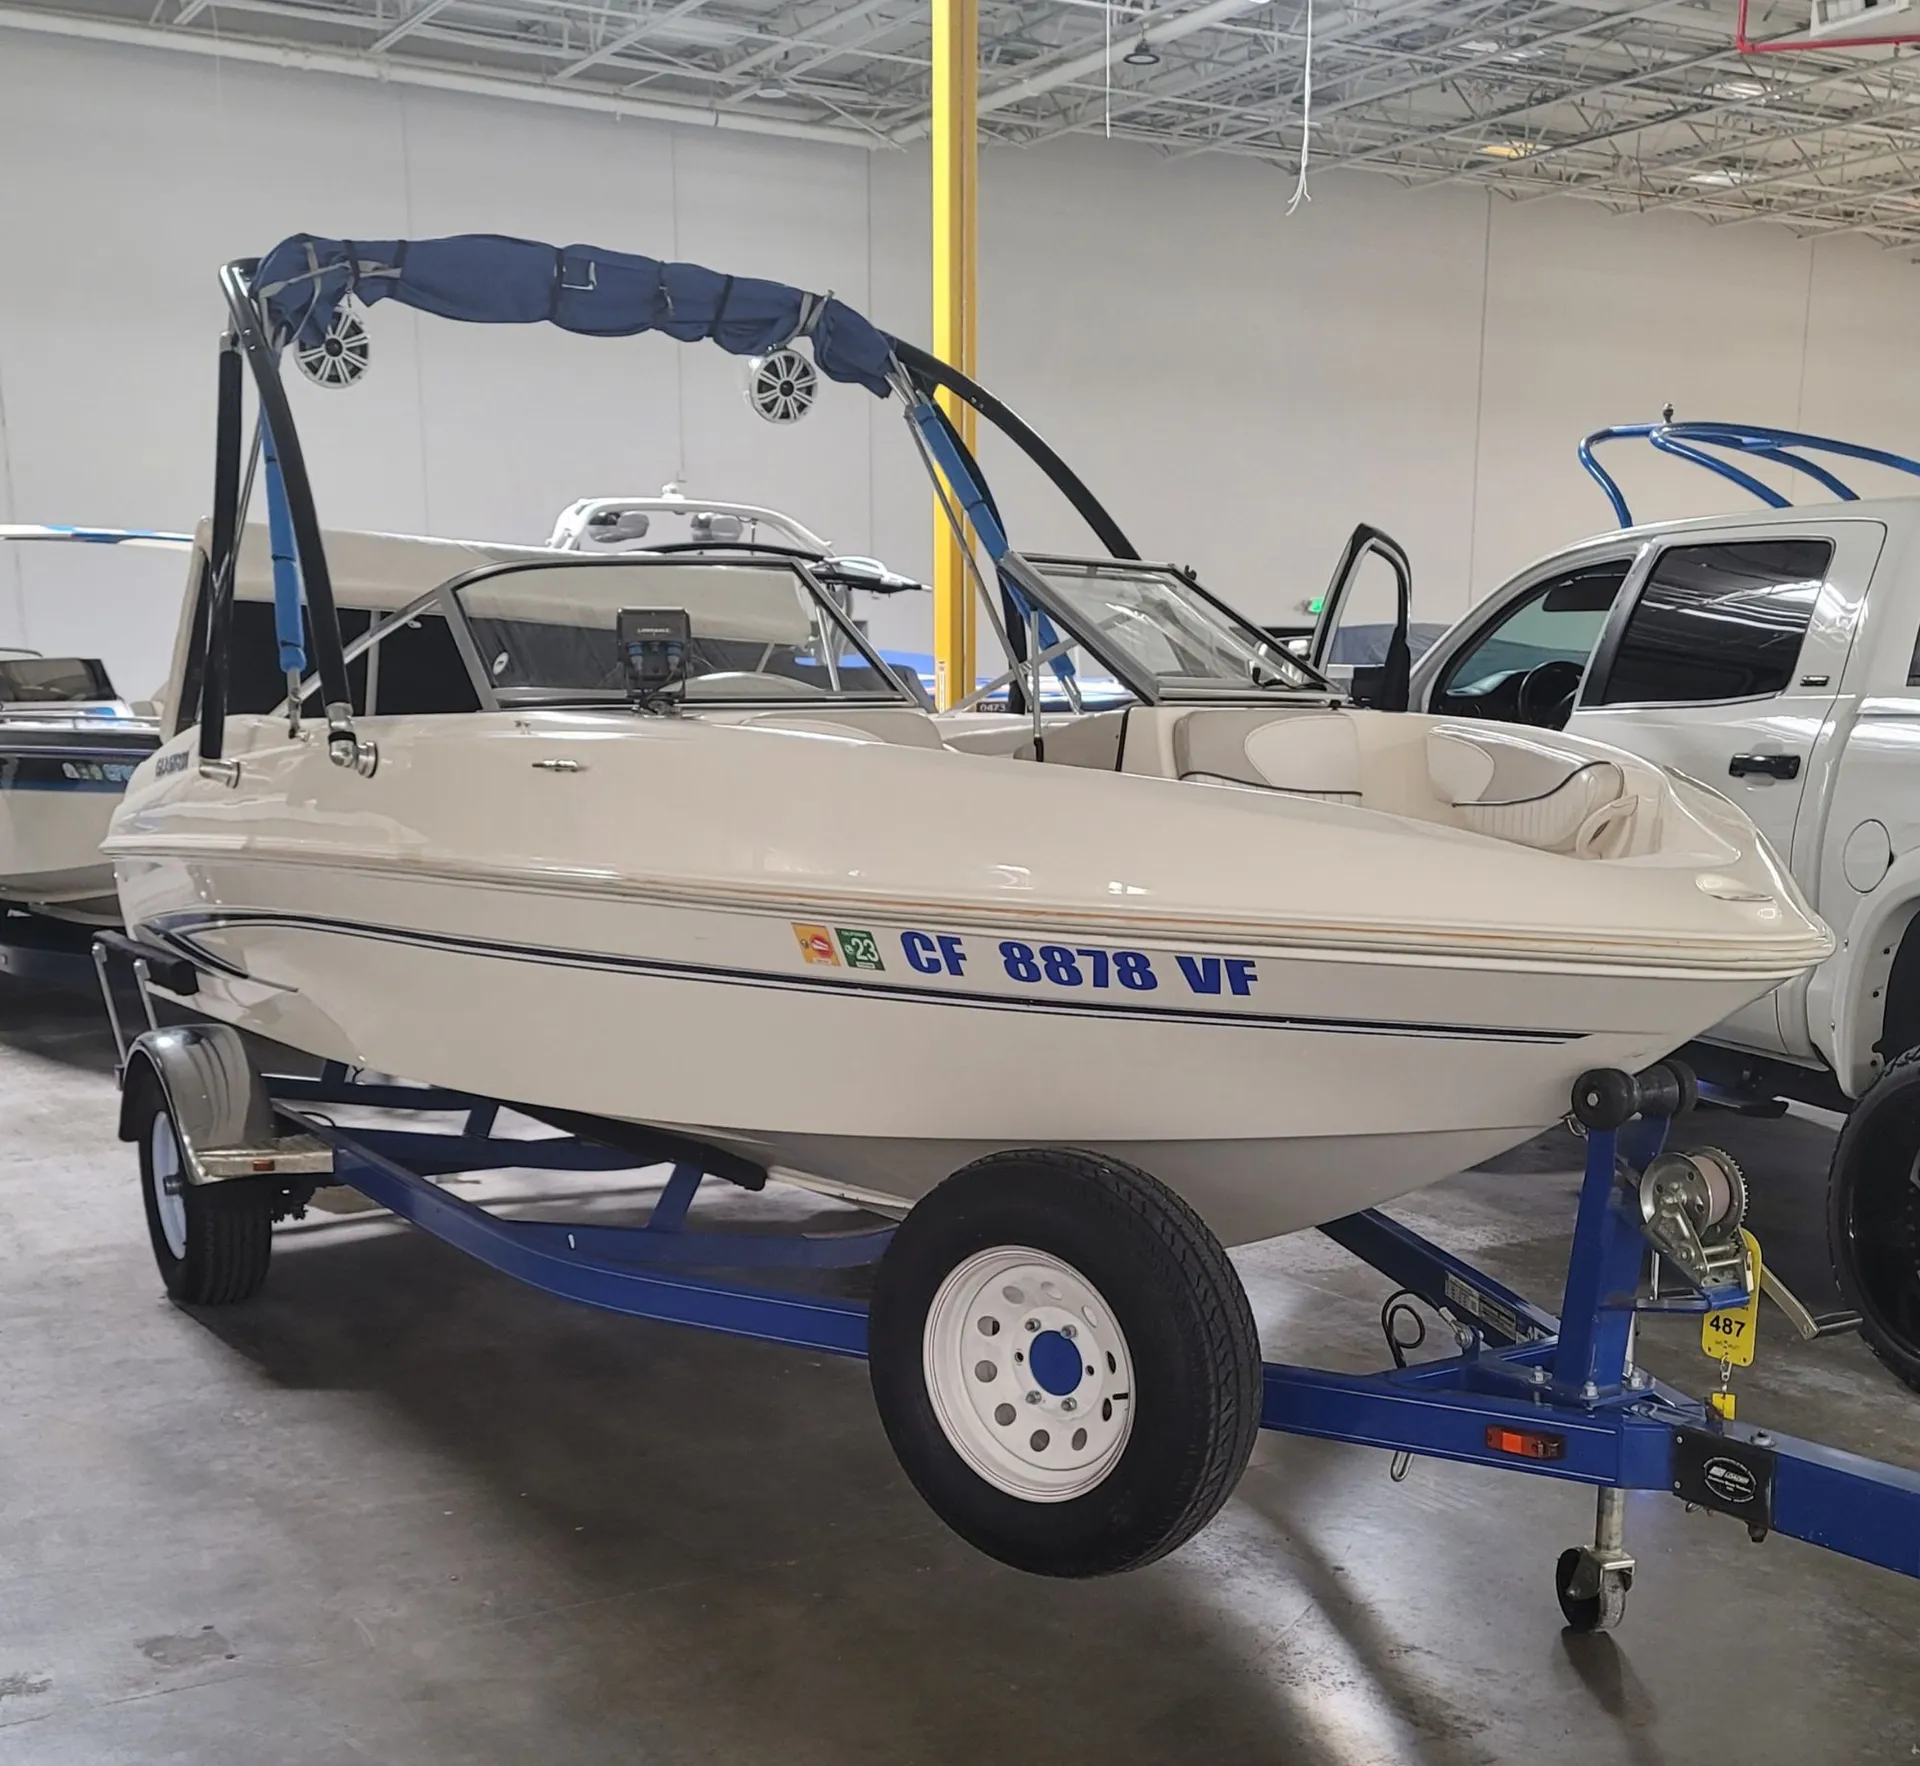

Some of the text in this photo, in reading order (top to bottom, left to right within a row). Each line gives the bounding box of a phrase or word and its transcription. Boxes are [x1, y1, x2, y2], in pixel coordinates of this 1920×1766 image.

[851, 937, 879, 963] 23
[900, 930, 1258, 996] CF 8878 VF
[1709, 1314, 1746, 1338] 487
